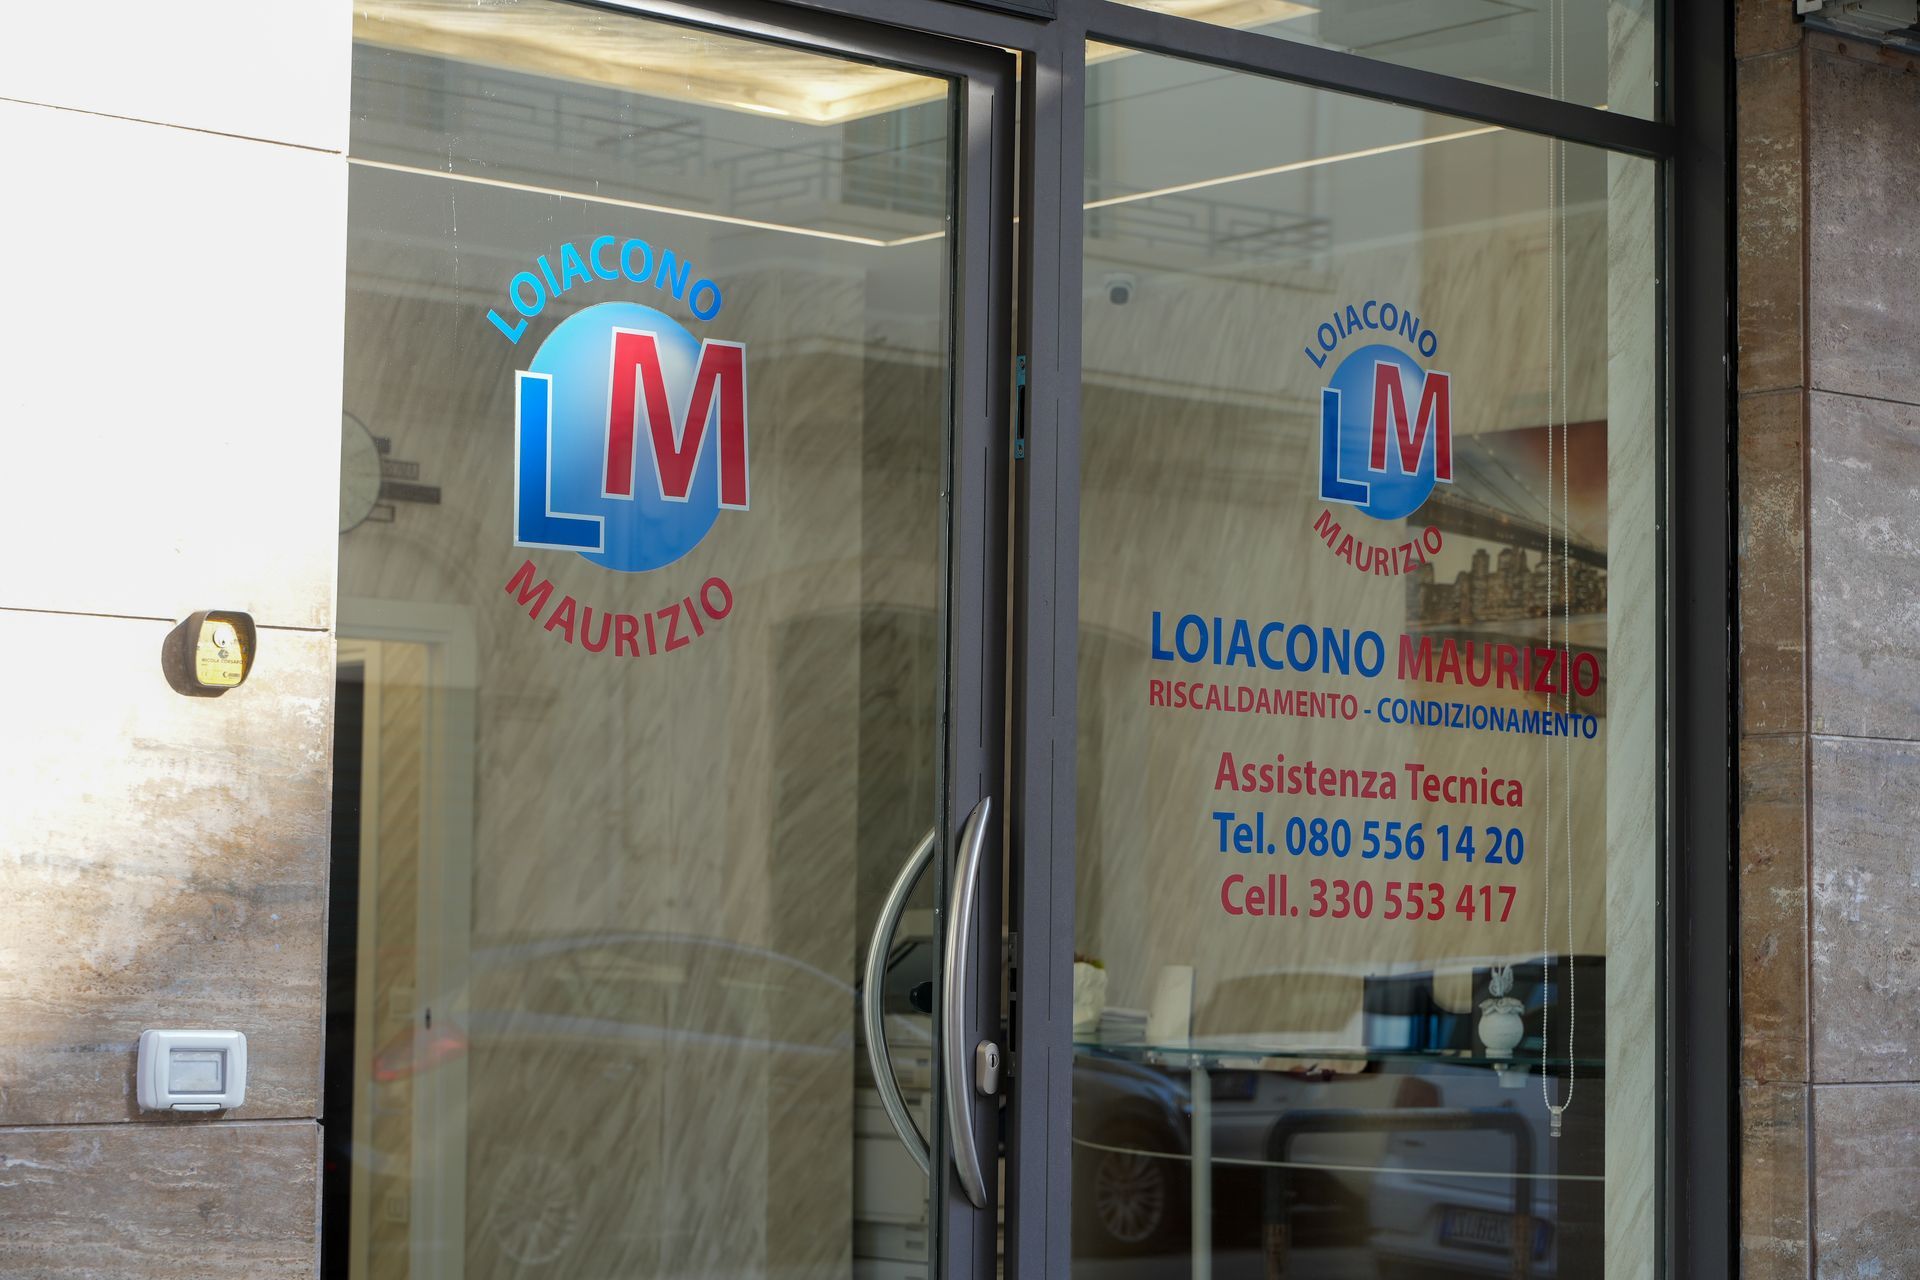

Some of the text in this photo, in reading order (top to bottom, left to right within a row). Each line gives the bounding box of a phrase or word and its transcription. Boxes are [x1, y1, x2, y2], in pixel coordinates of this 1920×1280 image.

[486, 235, 722, 345] LOIACONO
[1304, 300, 1438, 369] LOIACONO
[513, 326, 750, 554] LM
[1318, 360, 1453, 507] LM
[1313, 508, 1443, 577] MAURIZIO
[504, 559, 734, 658] MAURIZIO
[1151, 611, 1601, 698] LOIACONO MAURIZIO
[1149, 679, 1358, 721] RISCALDAMENTO
[1377, 697, 1598, 739] CONDIZIONAMENTO
[1215, 751, 1523, 807] Assistenza Tecnica
[1212, 811, 1525, 865] Tel. 080 556 14 20
[1221, 874, 1517, 922] Cell. 330 553 417
